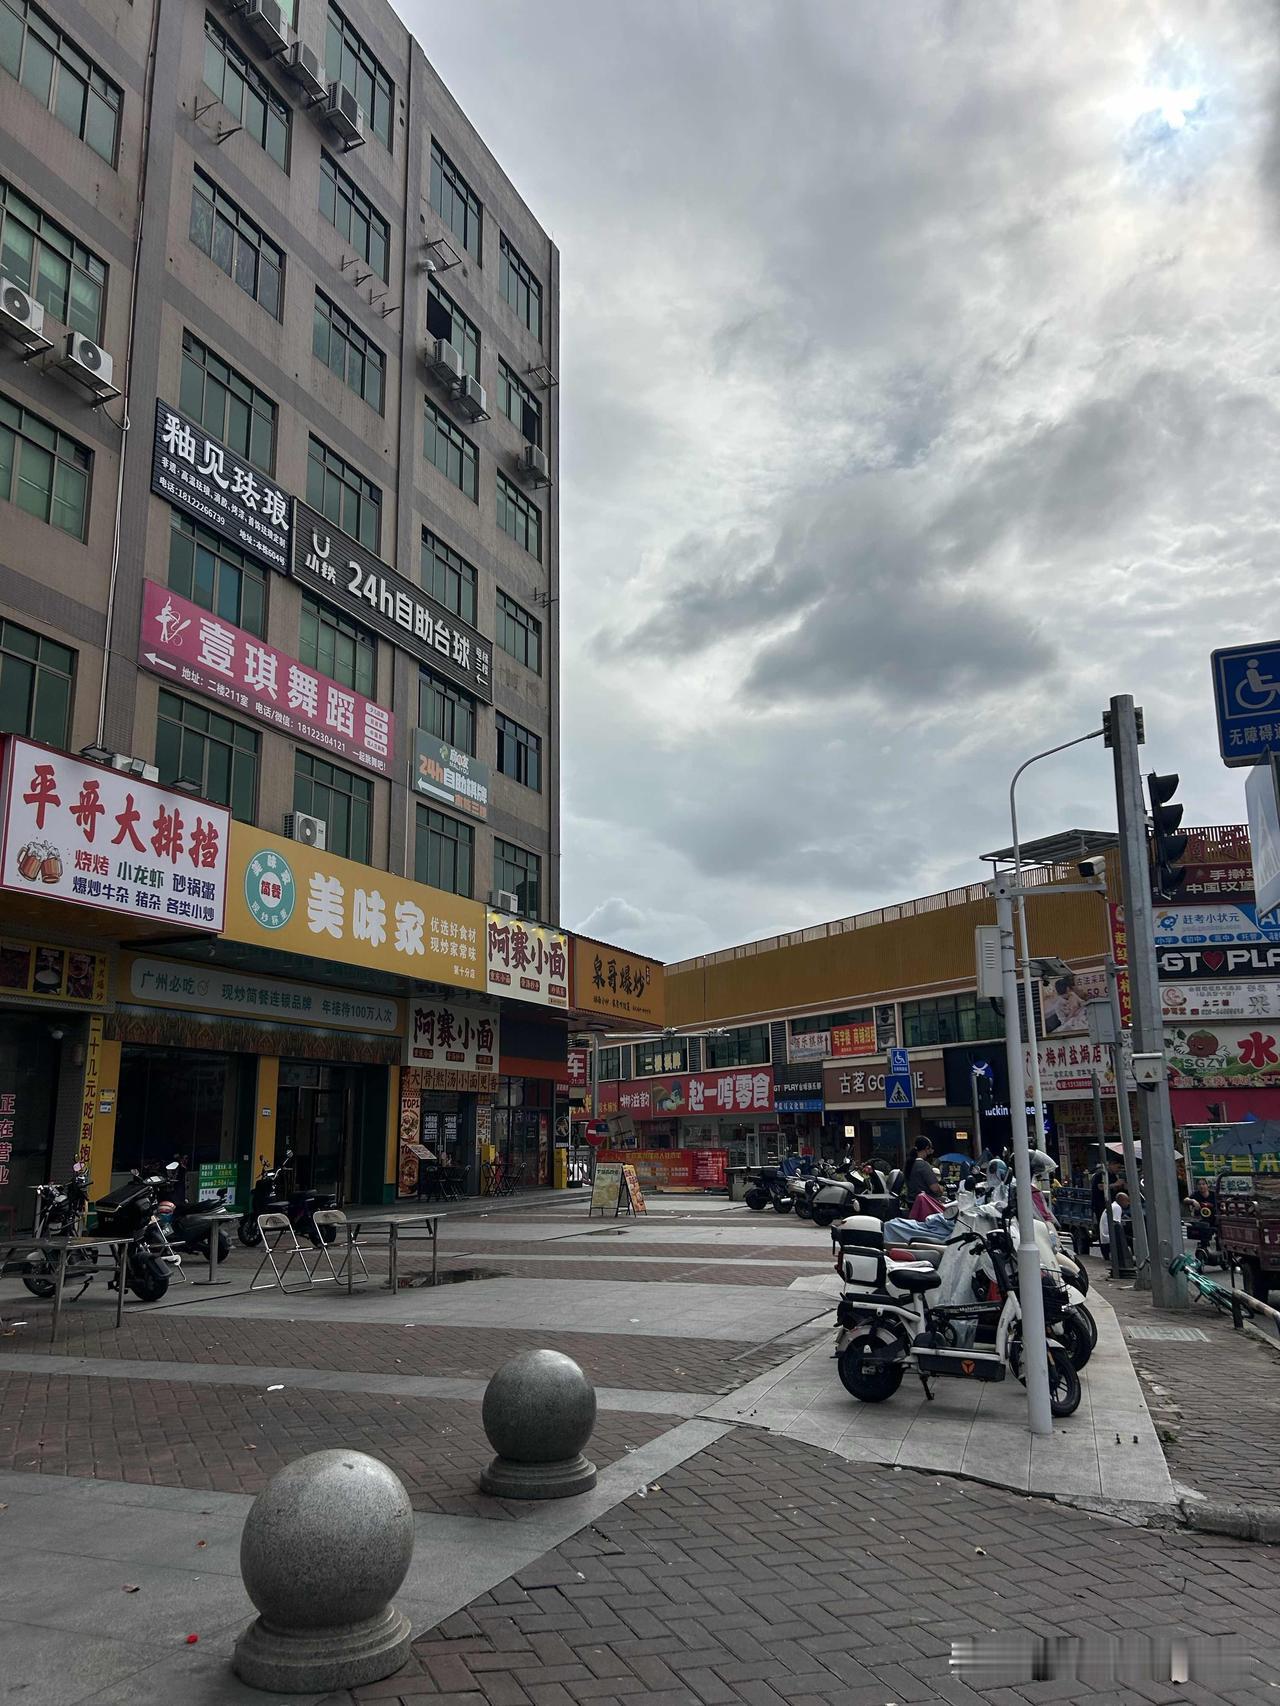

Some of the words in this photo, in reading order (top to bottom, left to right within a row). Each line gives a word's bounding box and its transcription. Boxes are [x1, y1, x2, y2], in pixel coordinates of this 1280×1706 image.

[305, 554, 336, 584] 小铁
[348, 560, 471, 670] 24h自助台球
[198, 618, 355, 738] 壹琪舞蹈
[75, 850, 110, 876] 烧烤
[117, 860, 165, 889] 小龙虾
[172, 872, 216, 900] 砂锅粥
[260, 880, 282, 900] 简餐
[72, 876, 129, 904] 爆炒牛杂
[136, 889, 161, 910] 猪杂
[166, 897, 215, 922] 各类小炒
[307, 871, 425, 956] 美味家
[430, 916, 476, 943] 优选好食材
[1183, 912, 1240, 925] 赶考小状元
[430, 936, 476, 961] 现炒家常味
[1161, 952, 1201, 973] GT
[140, 970, 194, 995] 广州必吃
[221, 983, 312, 1011] 现炒简餐连锁品牌
[321, 1000, 392, 1023] 年接待100万人次
[1184, 1059, 1226, 1068] SGZY
[1237, 1031, 1279, 1069] 水
[80, 1017, 101, 1164] 二十几元吃到饱
[688, 1073, 771, 1112] 赵一鸣零食
[839, 1071, 865, 1094] 古茗
